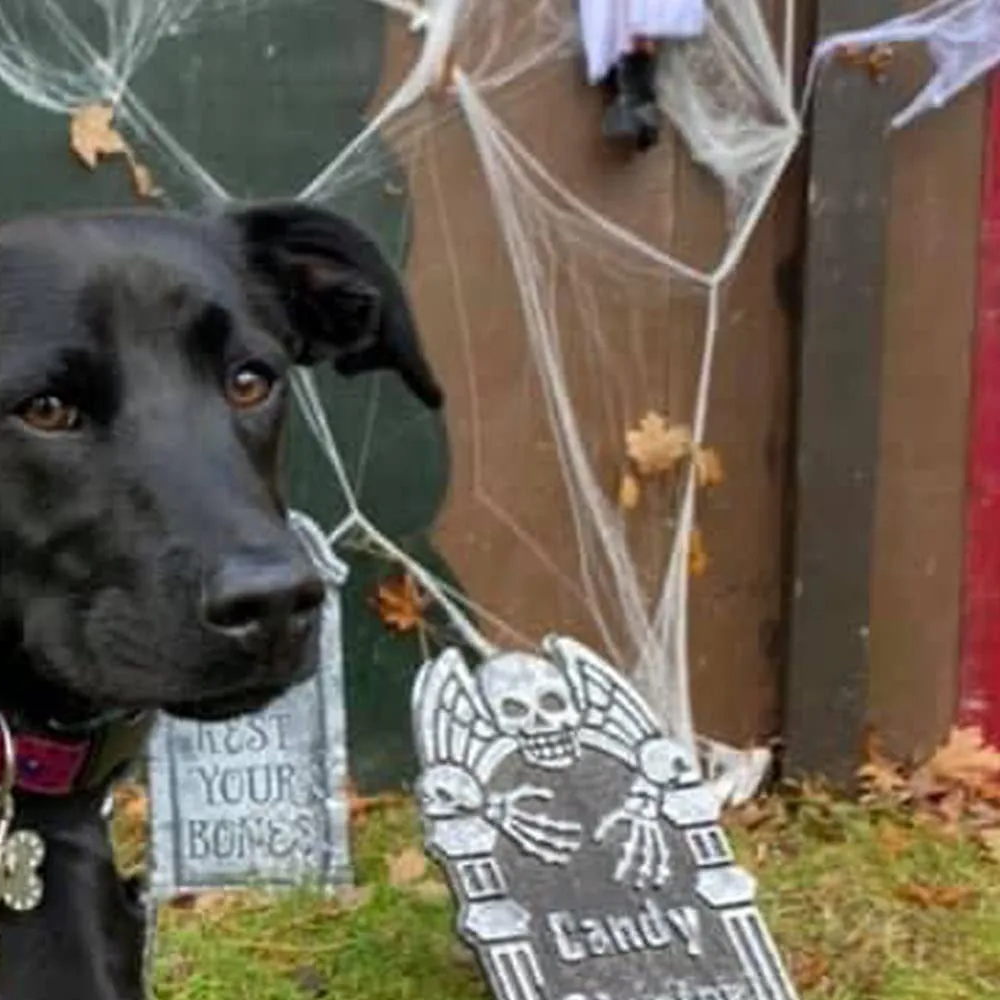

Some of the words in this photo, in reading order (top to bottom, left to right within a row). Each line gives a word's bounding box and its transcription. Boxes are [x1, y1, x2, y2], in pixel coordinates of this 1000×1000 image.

[197, 713, 291, 754] REST
[190, 763, 297, 805] YOUR
[188, 815, 317, 859] BONES
[547, 899, 702, 963] Candy
